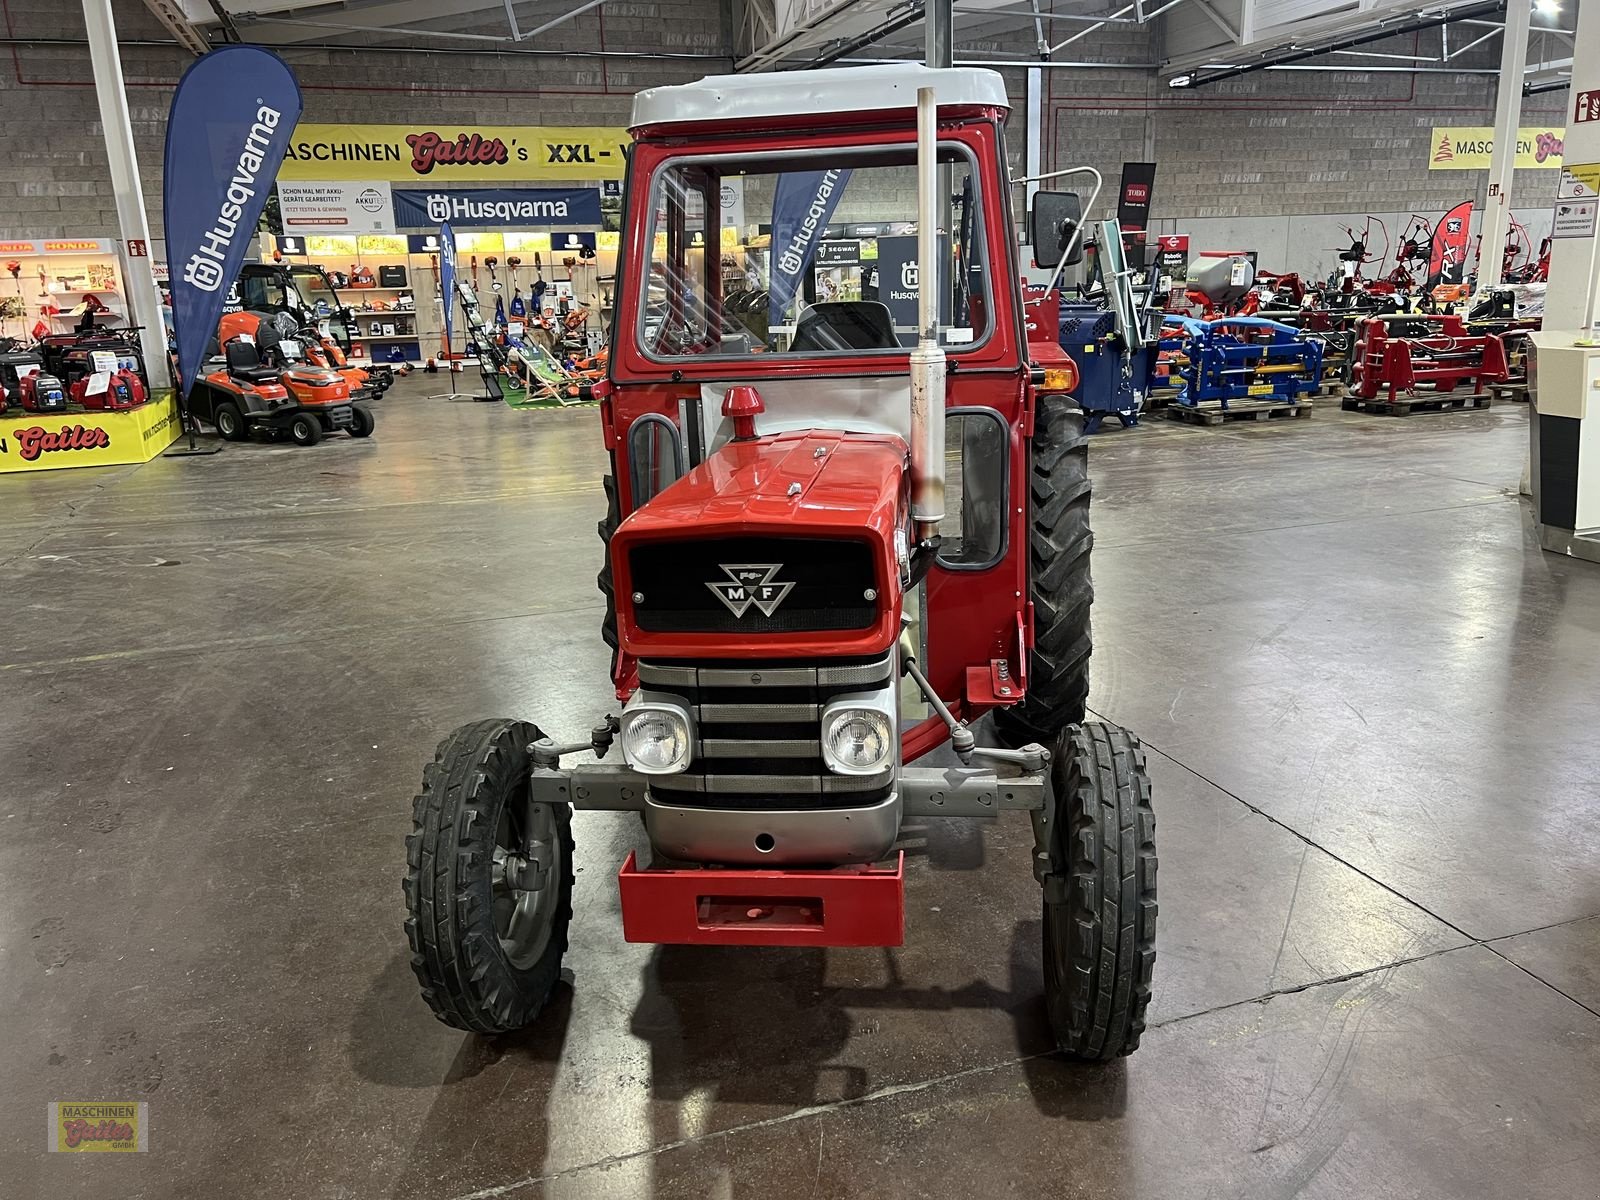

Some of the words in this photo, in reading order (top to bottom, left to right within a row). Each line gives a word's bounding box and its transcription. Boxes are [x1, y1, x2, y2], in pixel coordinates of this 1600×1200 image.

[283, 143, 400, 161] ASCHINEN
[1456, 141, 1531, 154] MASCEN
[199, 104, 281, 260] Husqvarna
[452, 197, 568, 221] Husqvarna
[45, 242, 98, 250] HONDA
[13, 424, 110, 461] Gailer
